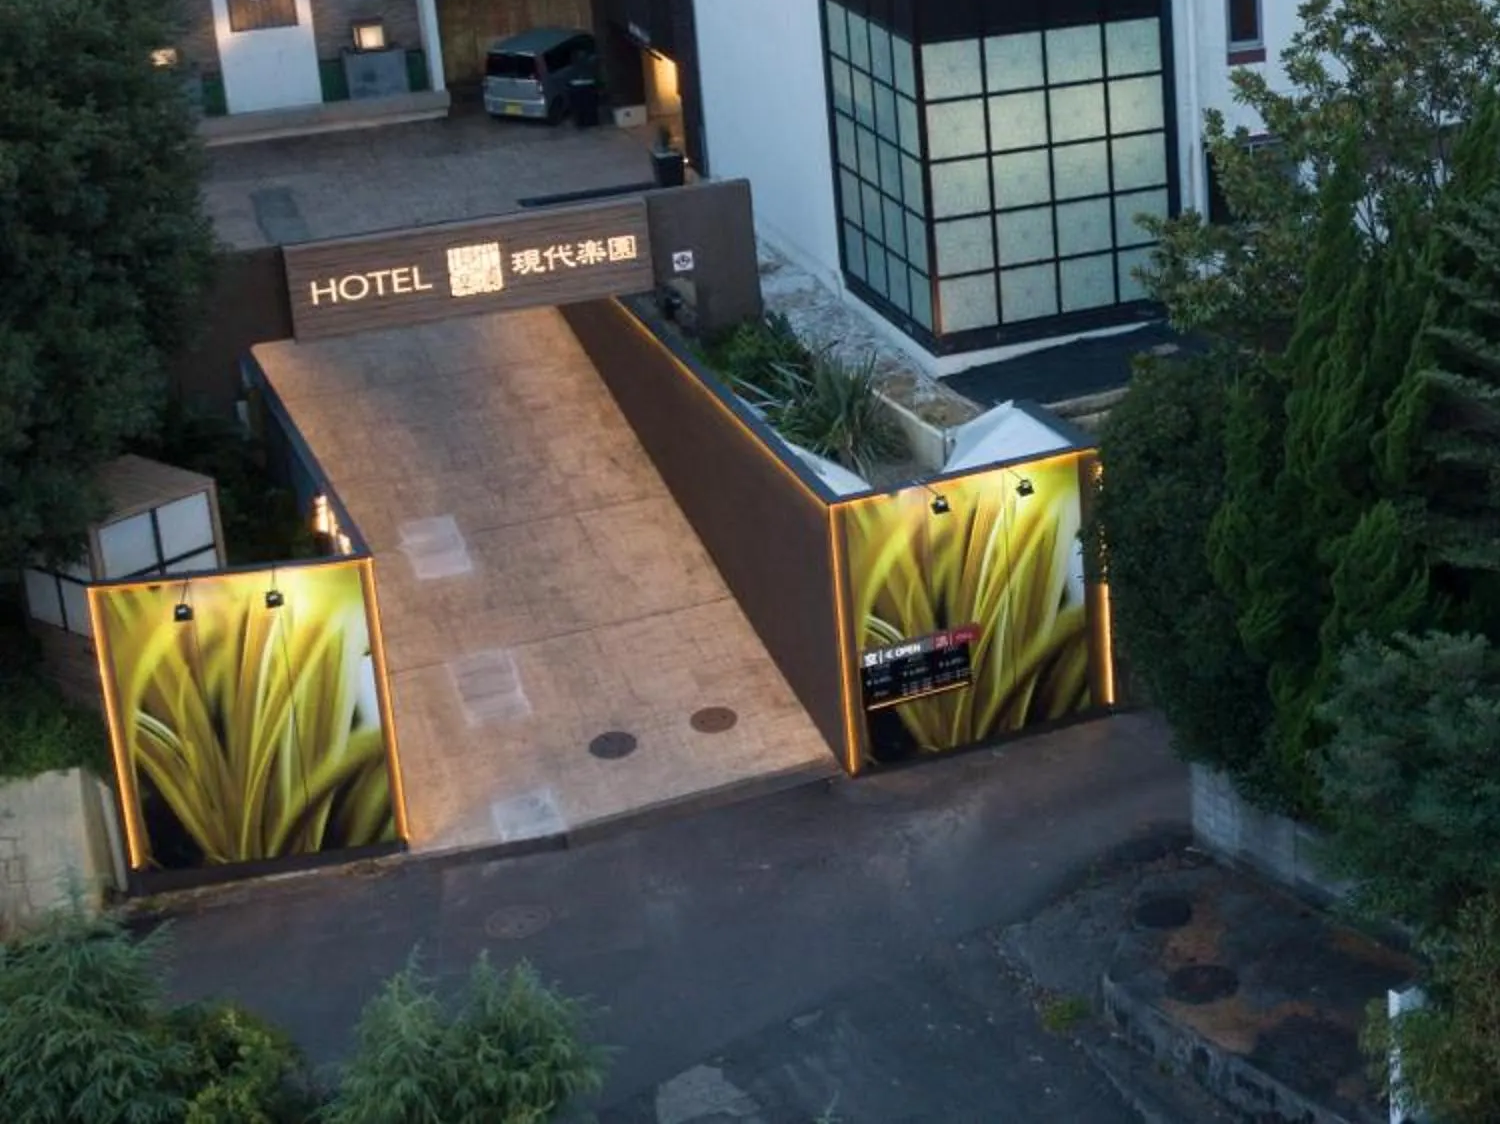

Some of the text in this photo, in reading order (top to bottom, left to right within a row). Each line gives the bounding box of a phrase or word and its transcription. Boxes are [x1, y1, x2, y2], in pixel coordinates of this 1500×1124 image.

[511, 235, 637, 275] 現代楽園
[310, 266, 433, 305] HOTEL
